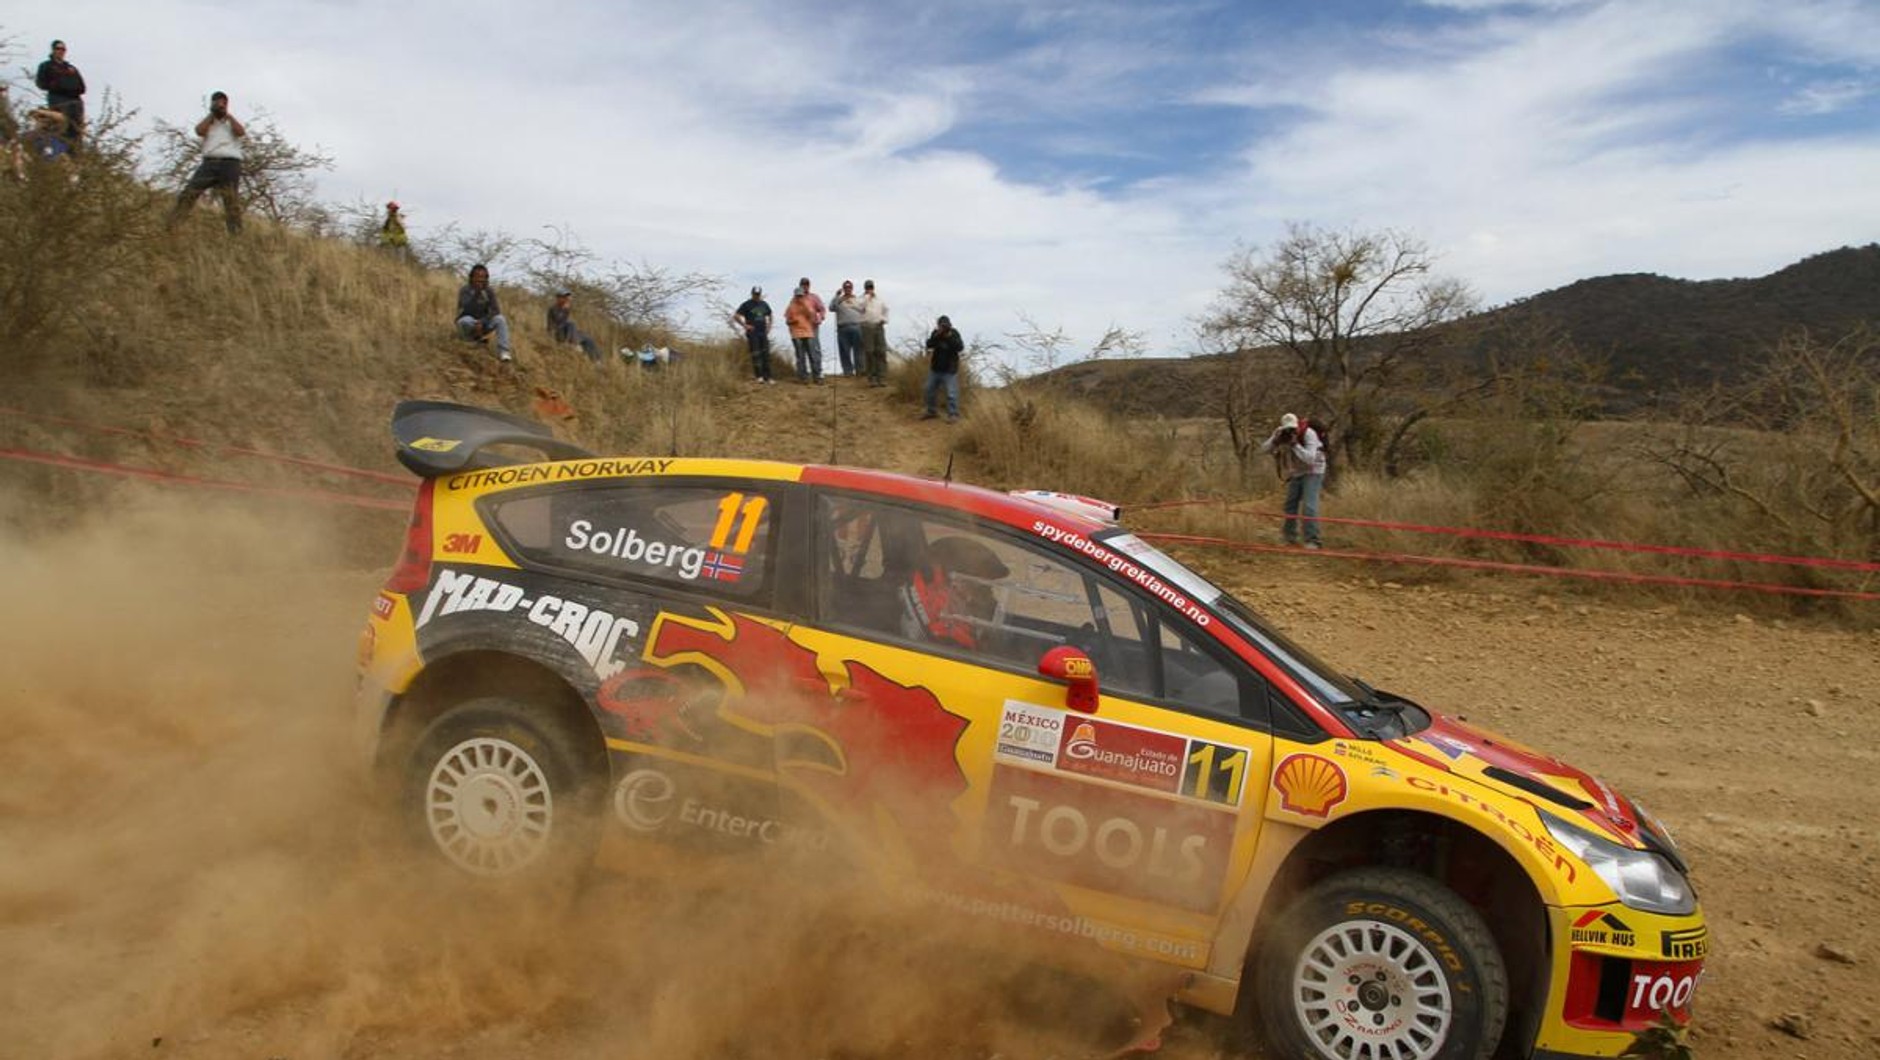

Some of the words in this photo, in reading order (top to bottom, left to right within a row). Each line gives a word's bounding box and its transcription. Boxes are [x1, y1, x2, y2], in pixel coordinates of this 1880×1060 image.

[449, 466, 550, 490] CITROEN
[556, 459, 674, 479] NORWAY
[443, 534, 482, 554] 3M
[709, 491, 767, 554] 11
[566, 519, 706, 579] Solberg
[1033, 520, 1210, 626] spydebergreklame.no
[415, 569, 639, 680] MAD-CROC
[1002, 723, 1057, 747] 2010
[1005, 711, 1060, 730] MÉXICO
[1067, 740, 1177, 776] Guanajuato
[1190, 744, 1247, 804] 11
[1009, 795, 1206, 881] TOOLS
[1571, 929, 1607, 943] HELLVIK
[1612, 932, 1636, 946] HUS
